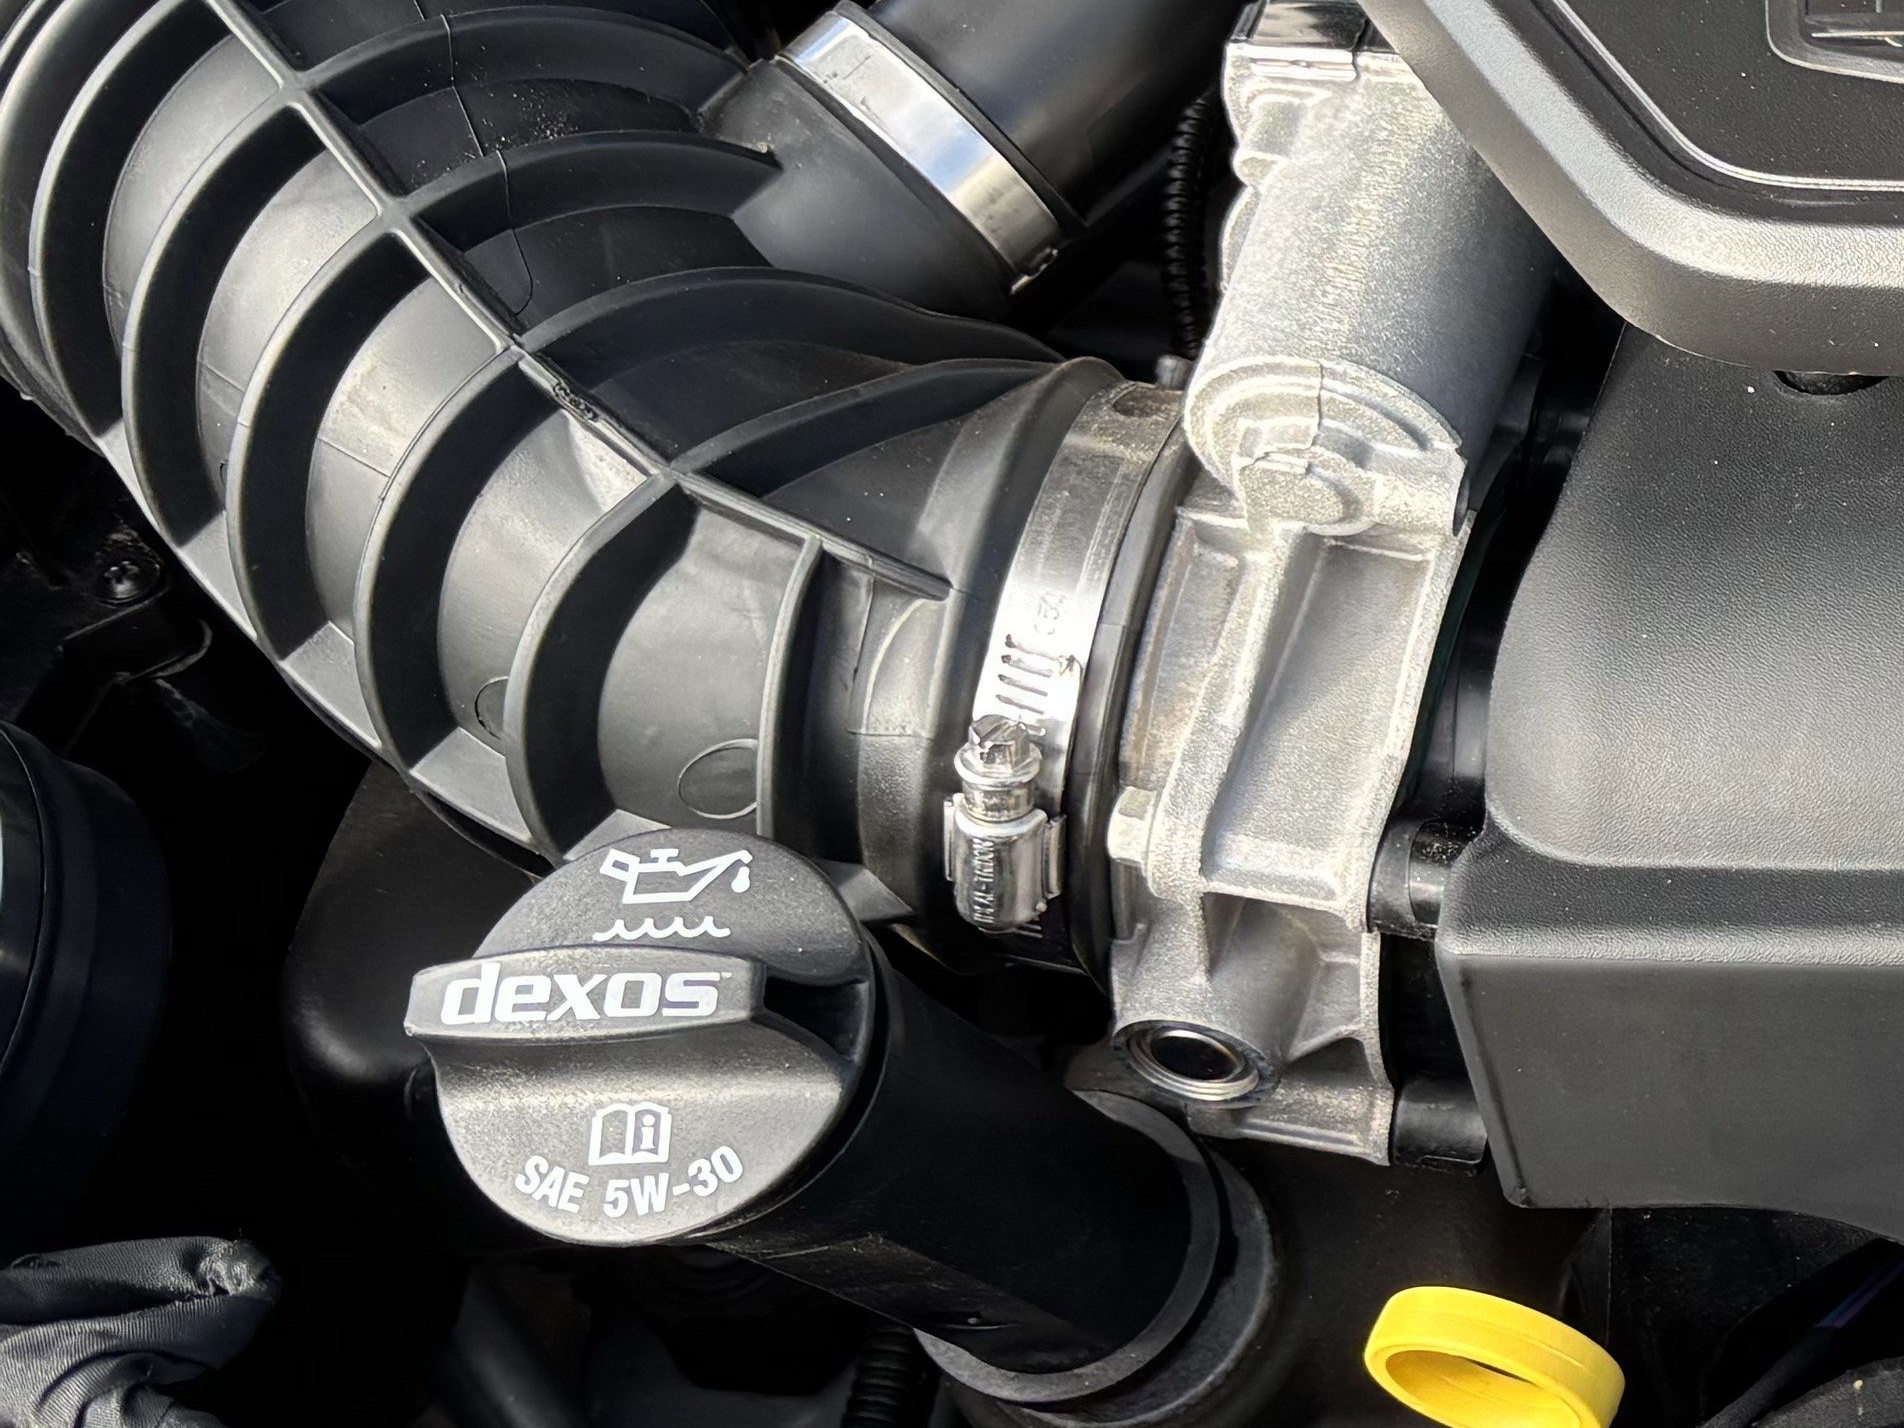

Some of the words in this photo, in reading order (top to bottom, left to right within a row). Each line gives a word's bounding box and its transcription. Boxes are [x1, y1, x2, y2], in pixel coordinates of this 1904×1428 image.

[440, 962, 721, 1025] dexos
[515, 1155, 590, 1213] SAE
[603, 1146, 743, 1219] 5W-30
